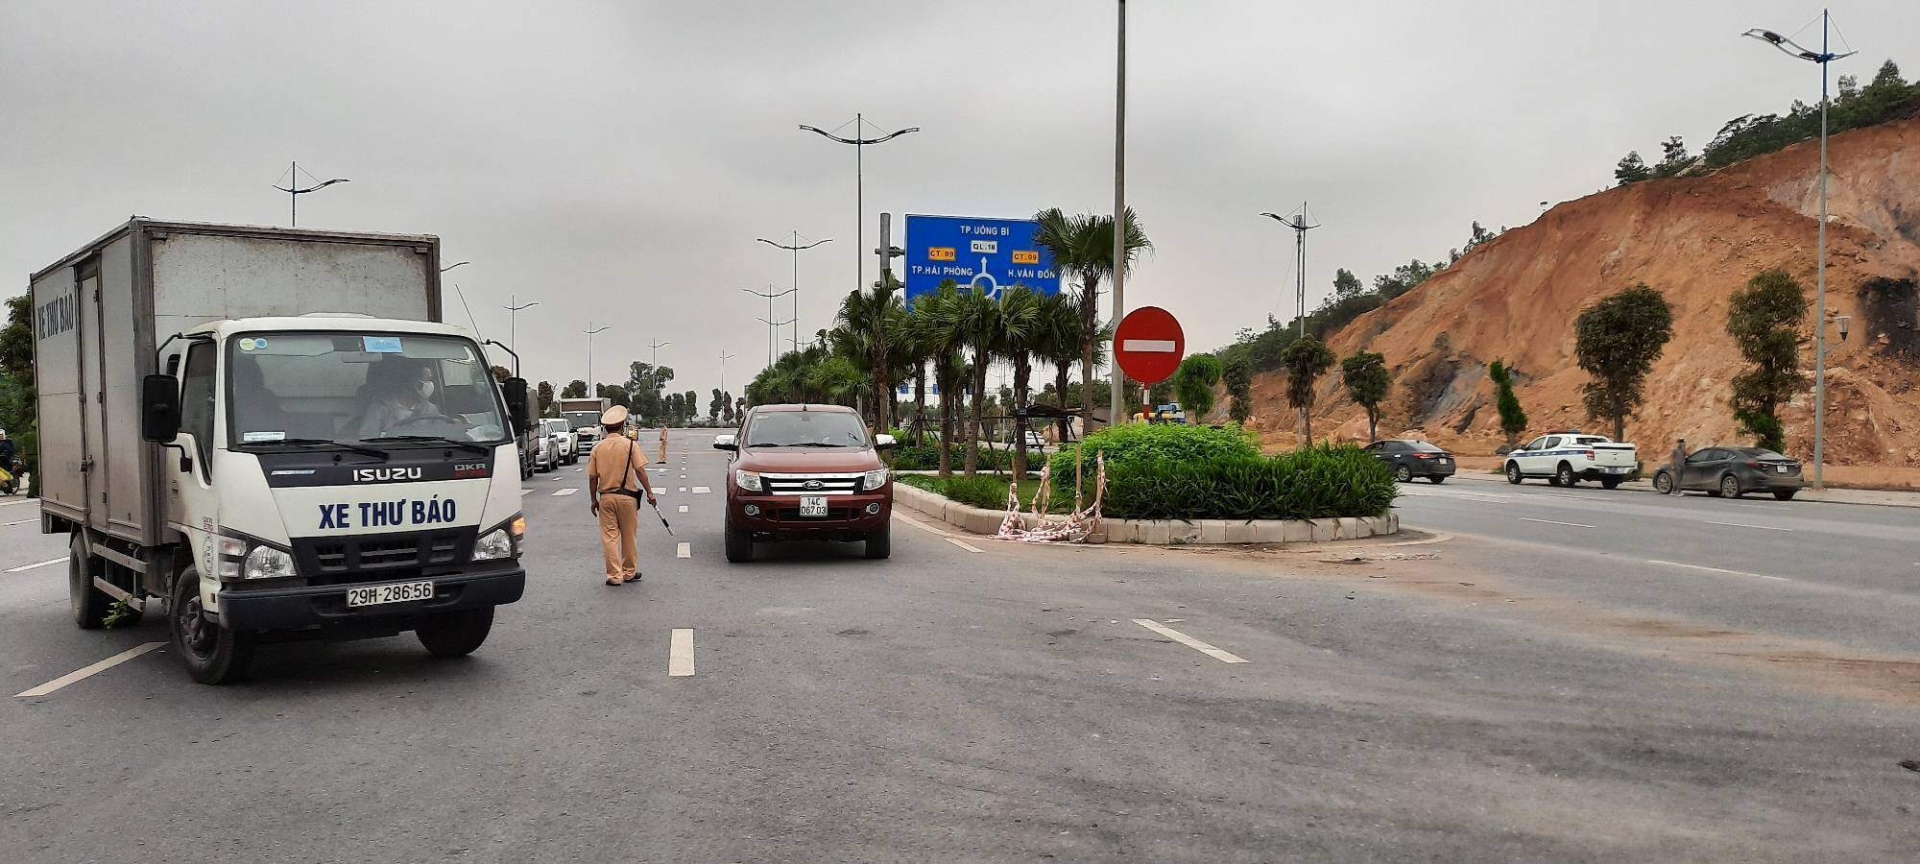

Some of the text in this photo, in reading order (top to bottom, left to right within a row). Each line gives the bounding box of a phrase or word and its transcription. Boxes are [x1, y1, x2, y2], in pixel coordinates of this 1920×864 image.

[1014, 253, 1037, 261] CT.09
[37, 287, 74, 341] XE THƯ BÁO
[353, 467, 422, 482] ISUZU
[807, 497, 821, 506] 14C
[318, 493, 456, 530] XE THƯ BÁO
[349, 582, 431, 606] 29H-286.56
